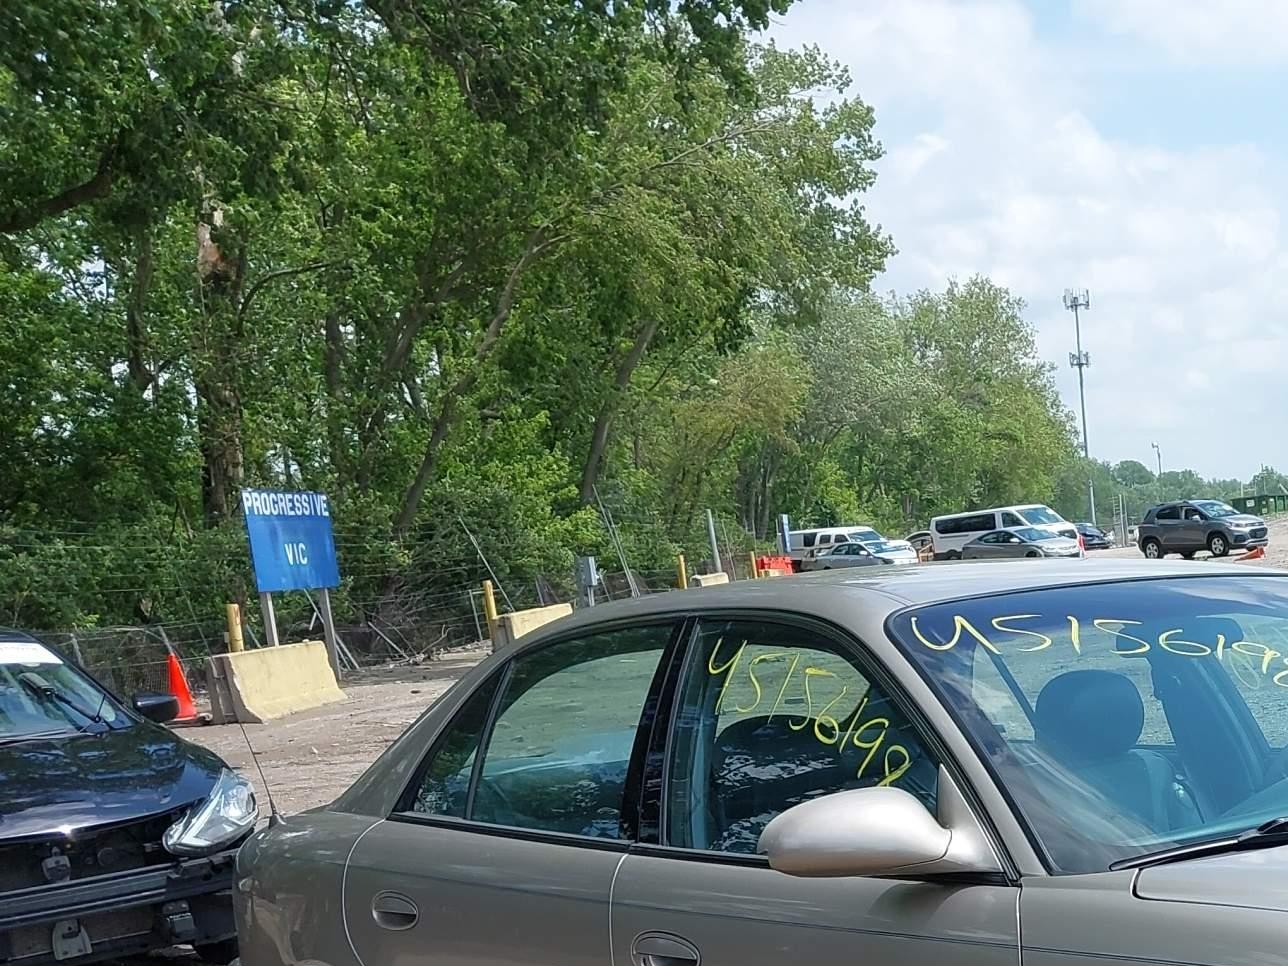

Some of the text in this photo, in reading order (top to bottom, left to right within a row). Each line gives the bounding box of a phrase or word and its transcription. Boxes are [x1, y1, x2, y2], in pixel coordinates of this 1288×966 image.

[242, 492, 329, 516] PROGRESSIVE
[284, 542, 308, 565] VIC
[708, 636, 913, 787] 45156198
